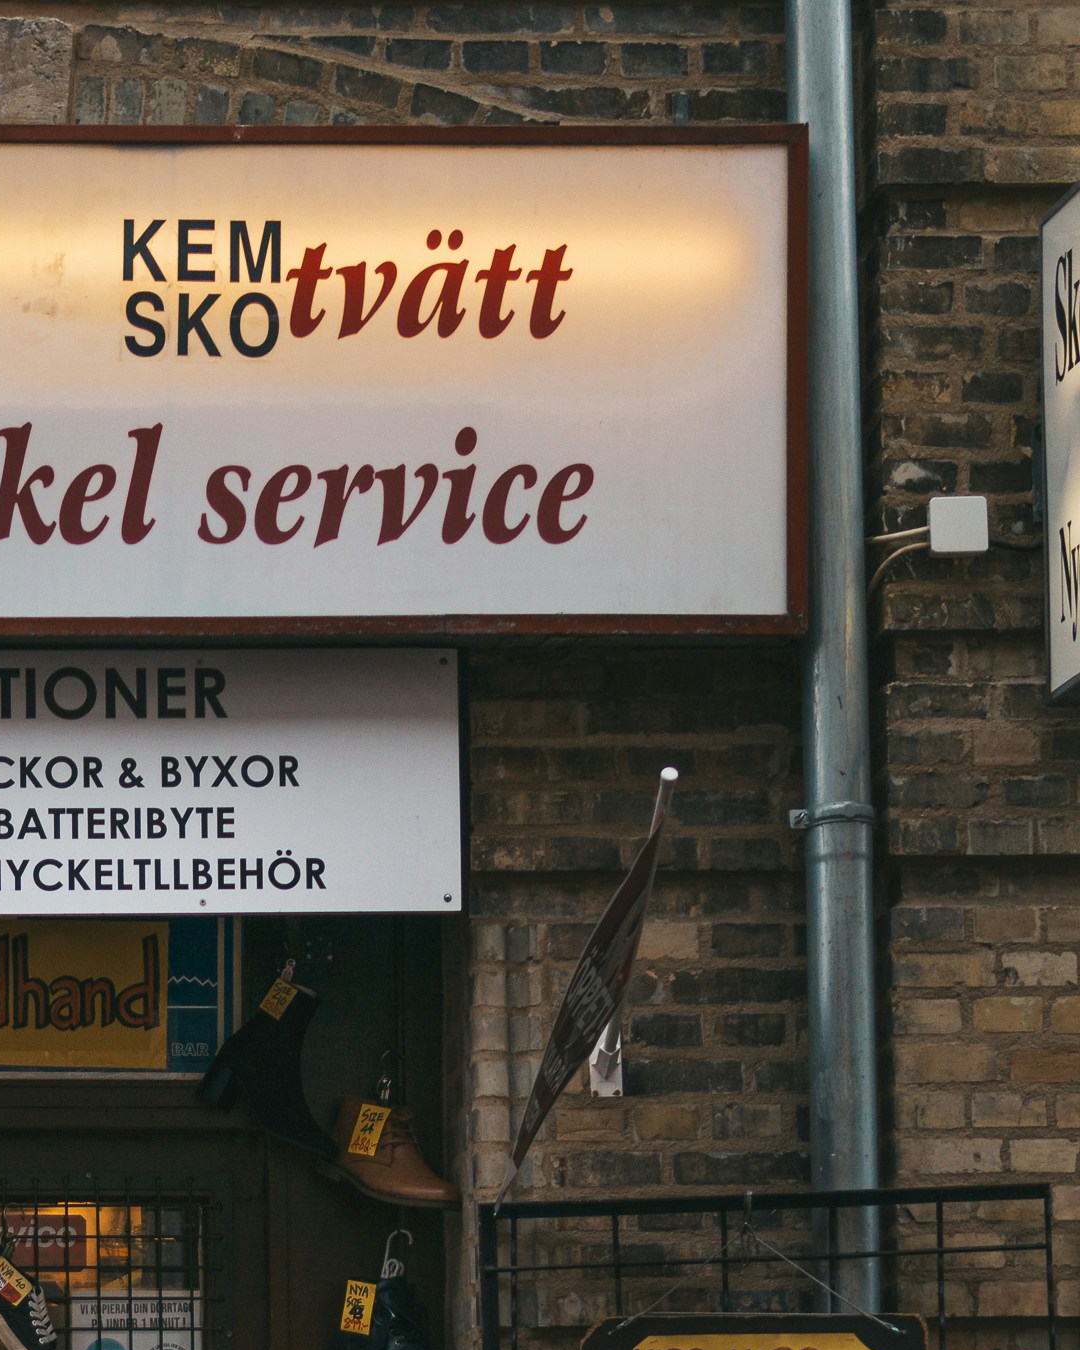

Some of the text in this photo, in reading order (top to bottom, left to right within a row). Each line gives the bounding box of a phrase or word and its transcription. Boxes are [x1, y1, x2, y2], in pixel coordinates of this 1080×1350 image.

[122, 219, 281, 283] KEM
[286, 229, 573, 339] tvätt
[124, 293, 279, 357] SKO
[197, 426, 594, 547] service
[118, 757, 144, 788] &
[161, 755, 300, 788] BYXOR
[171, 1042, 210, 1057] BAR
[361, 1108, 385, 1123] SIZE
[15, 1277, 26, 1290] 40
[349, 1284, 368, 1298] NYA
